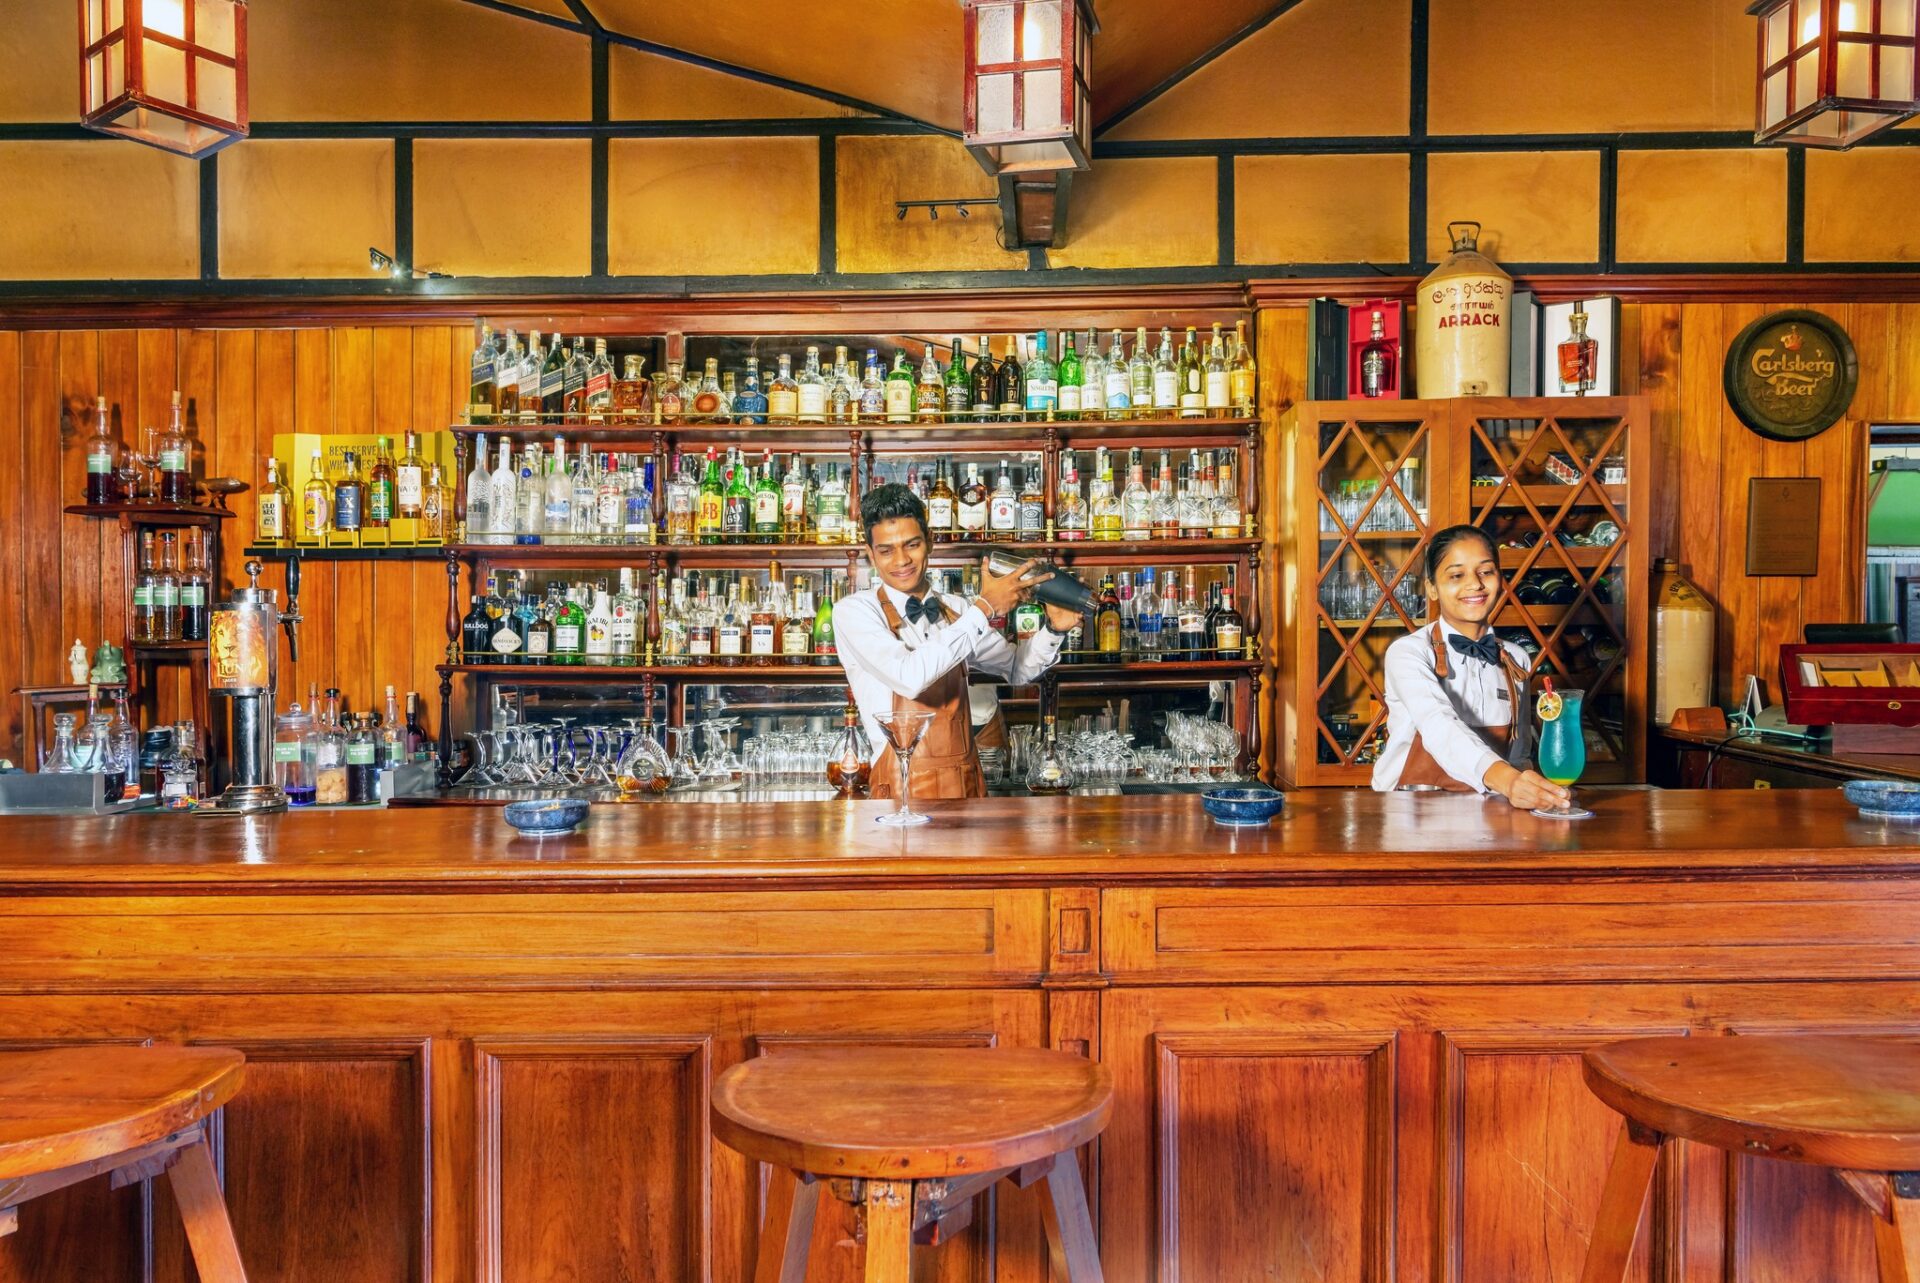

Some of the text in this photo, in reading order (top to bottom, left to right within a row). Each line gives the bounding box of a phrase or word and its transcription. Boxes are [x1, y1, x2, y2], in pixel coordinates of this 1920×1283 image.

[1438, 313, 1500, 329] ARRACK
[1751, 349, 1835, 378] Carlsberg
[1775, 379, 1817, 396] Beer
[329, 445, 378, 457] BEST SERVE
